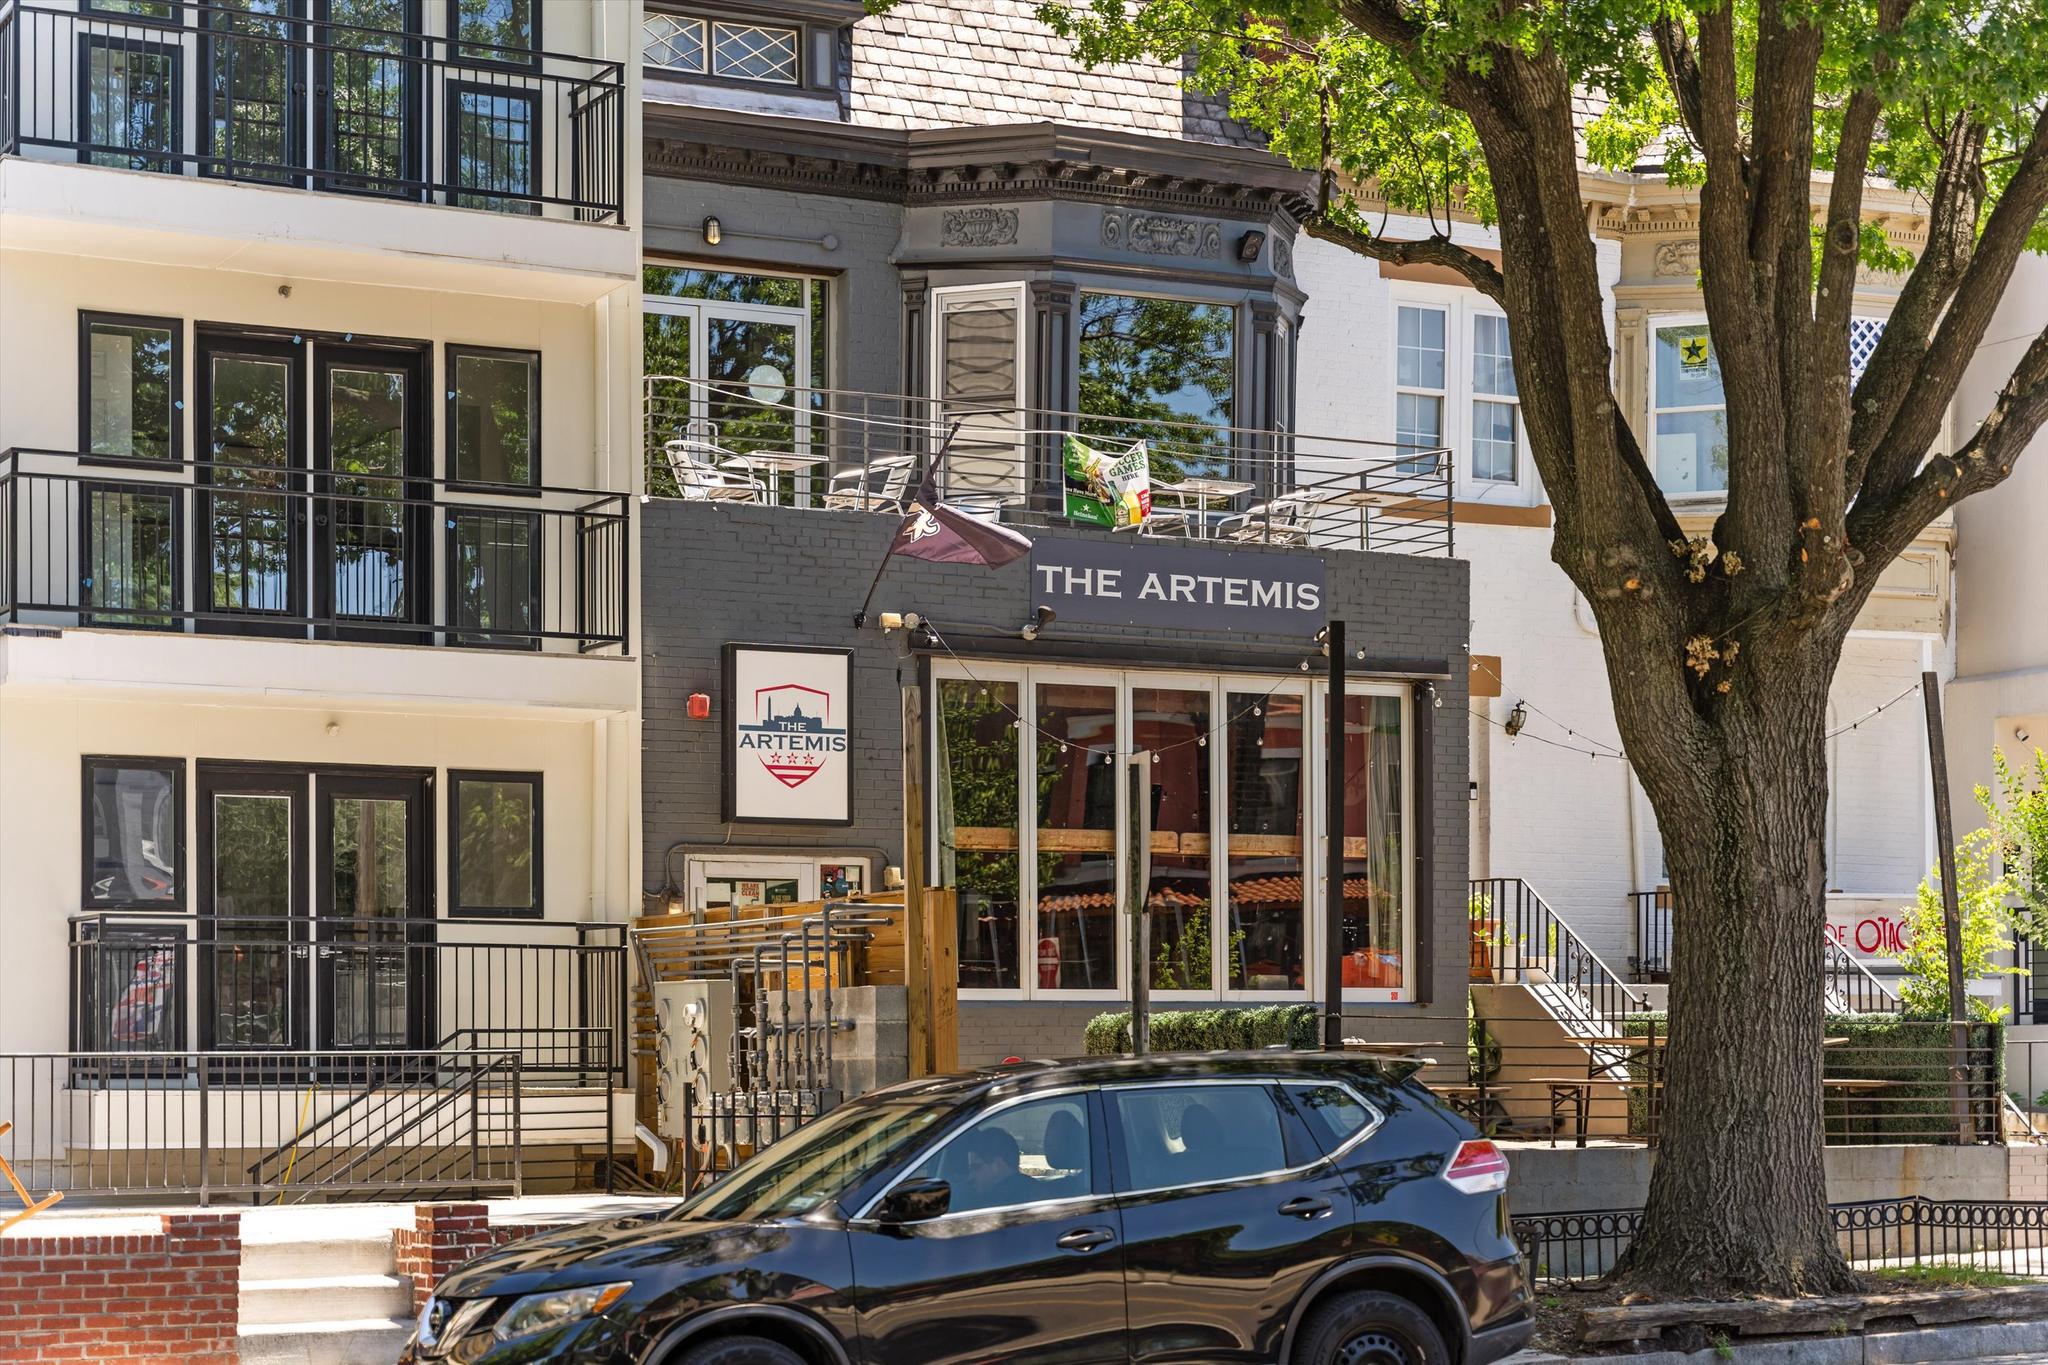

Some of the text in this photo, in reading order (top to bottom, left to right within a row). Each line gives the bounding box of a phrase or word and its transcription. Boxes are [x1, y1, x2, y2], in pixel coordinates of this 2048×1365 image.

[1109, 460, 1145, 477] GAMES
[1121, 472, 1139, 481] HERE
[1036, 564, 1320, 611] THE ARTEMIS
[778, 721, 807, 732] THE
[739, 733, 847, 752] ARTEMIS
